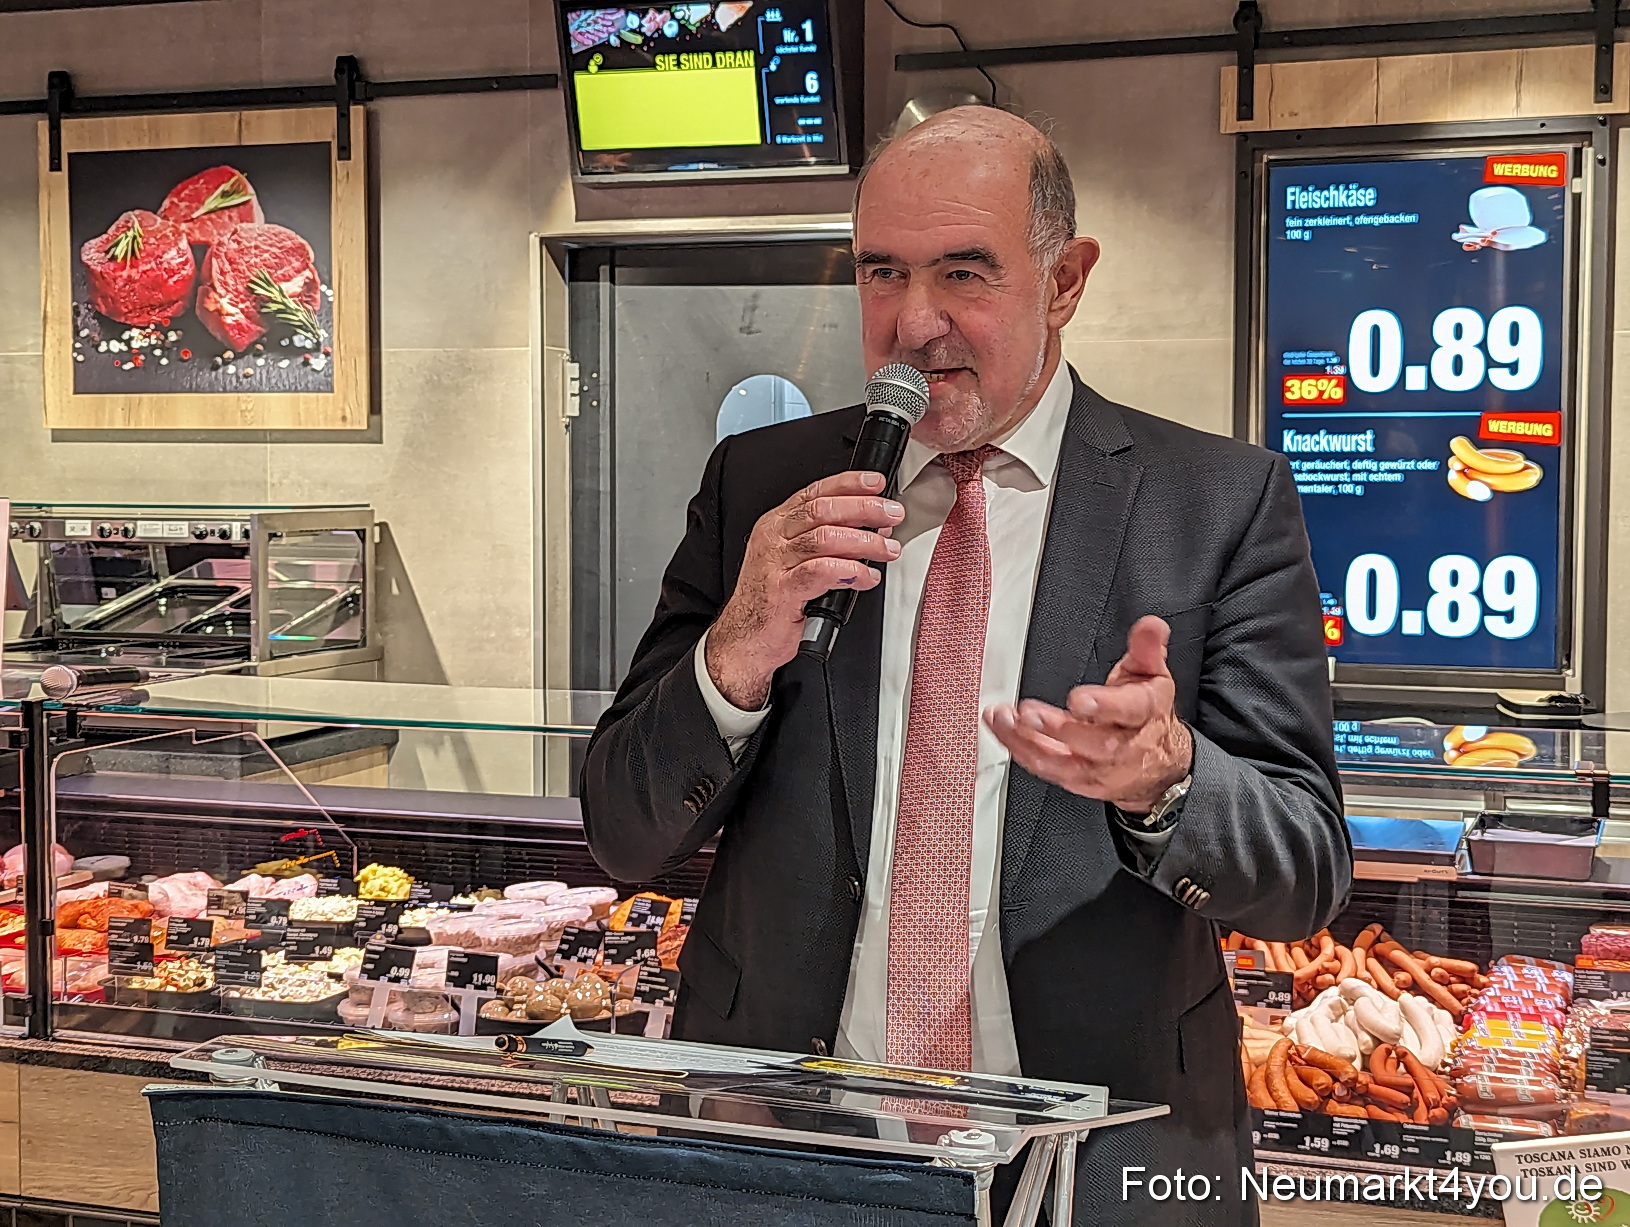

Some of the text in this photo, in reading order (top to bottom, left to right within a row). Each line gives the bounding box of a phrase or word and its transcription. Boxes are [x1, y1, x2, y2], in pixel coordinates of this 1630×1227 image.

[801, 18, 814, 42] 1
[655, 50, 755, 71] SIE SIND DRAN
[805, 71, 819, 94] 6
[1493, 162, 1559, 178] WERBUNG
[1286, 183, 1377, 210] Fleischkäse
[1285, 212, 1419, 227] fein zerkleinert, ofengebacken
[1285, 229, 1312, 241] 100 g
[1349, 305, 1544, 393] 0.89
[1285, 378, 1344, 400] 36%
[1488, 419, 1553, 437] WERBUNG
[1283, 429, 1375, 452] Knackwurst
[1351, 458, 1378, 471] deftig
[1379, 458, 1416, 472] gewürzt
[1416, 459, 1440, 470] oder
[1351, 471, 1367, 482] mit
[1368, 472, 1404, 482] echtem
[1338, 484, 1355, 494] 100
[1355, 485, 1365, 496] g
[1345, 553, 1540, 640] 0.89
[314, 945, 333, 956] 1.49
[1268, 990, 1291, 1002] 0.89
[1303, 1135, 1330, 1150] 1.59
[1373, 1142, 1400, 1156] 1.69
[1444, 1150, 1472, 1164] 1.89
[1515, 1150, 1576, 1165] TOSCANA
[1579, 1145, 1621, 1159] SIAMO
[1520, 1163, 1581, 1178] TOSKANA
[1584, 1160, 1617, 1173] SIND
